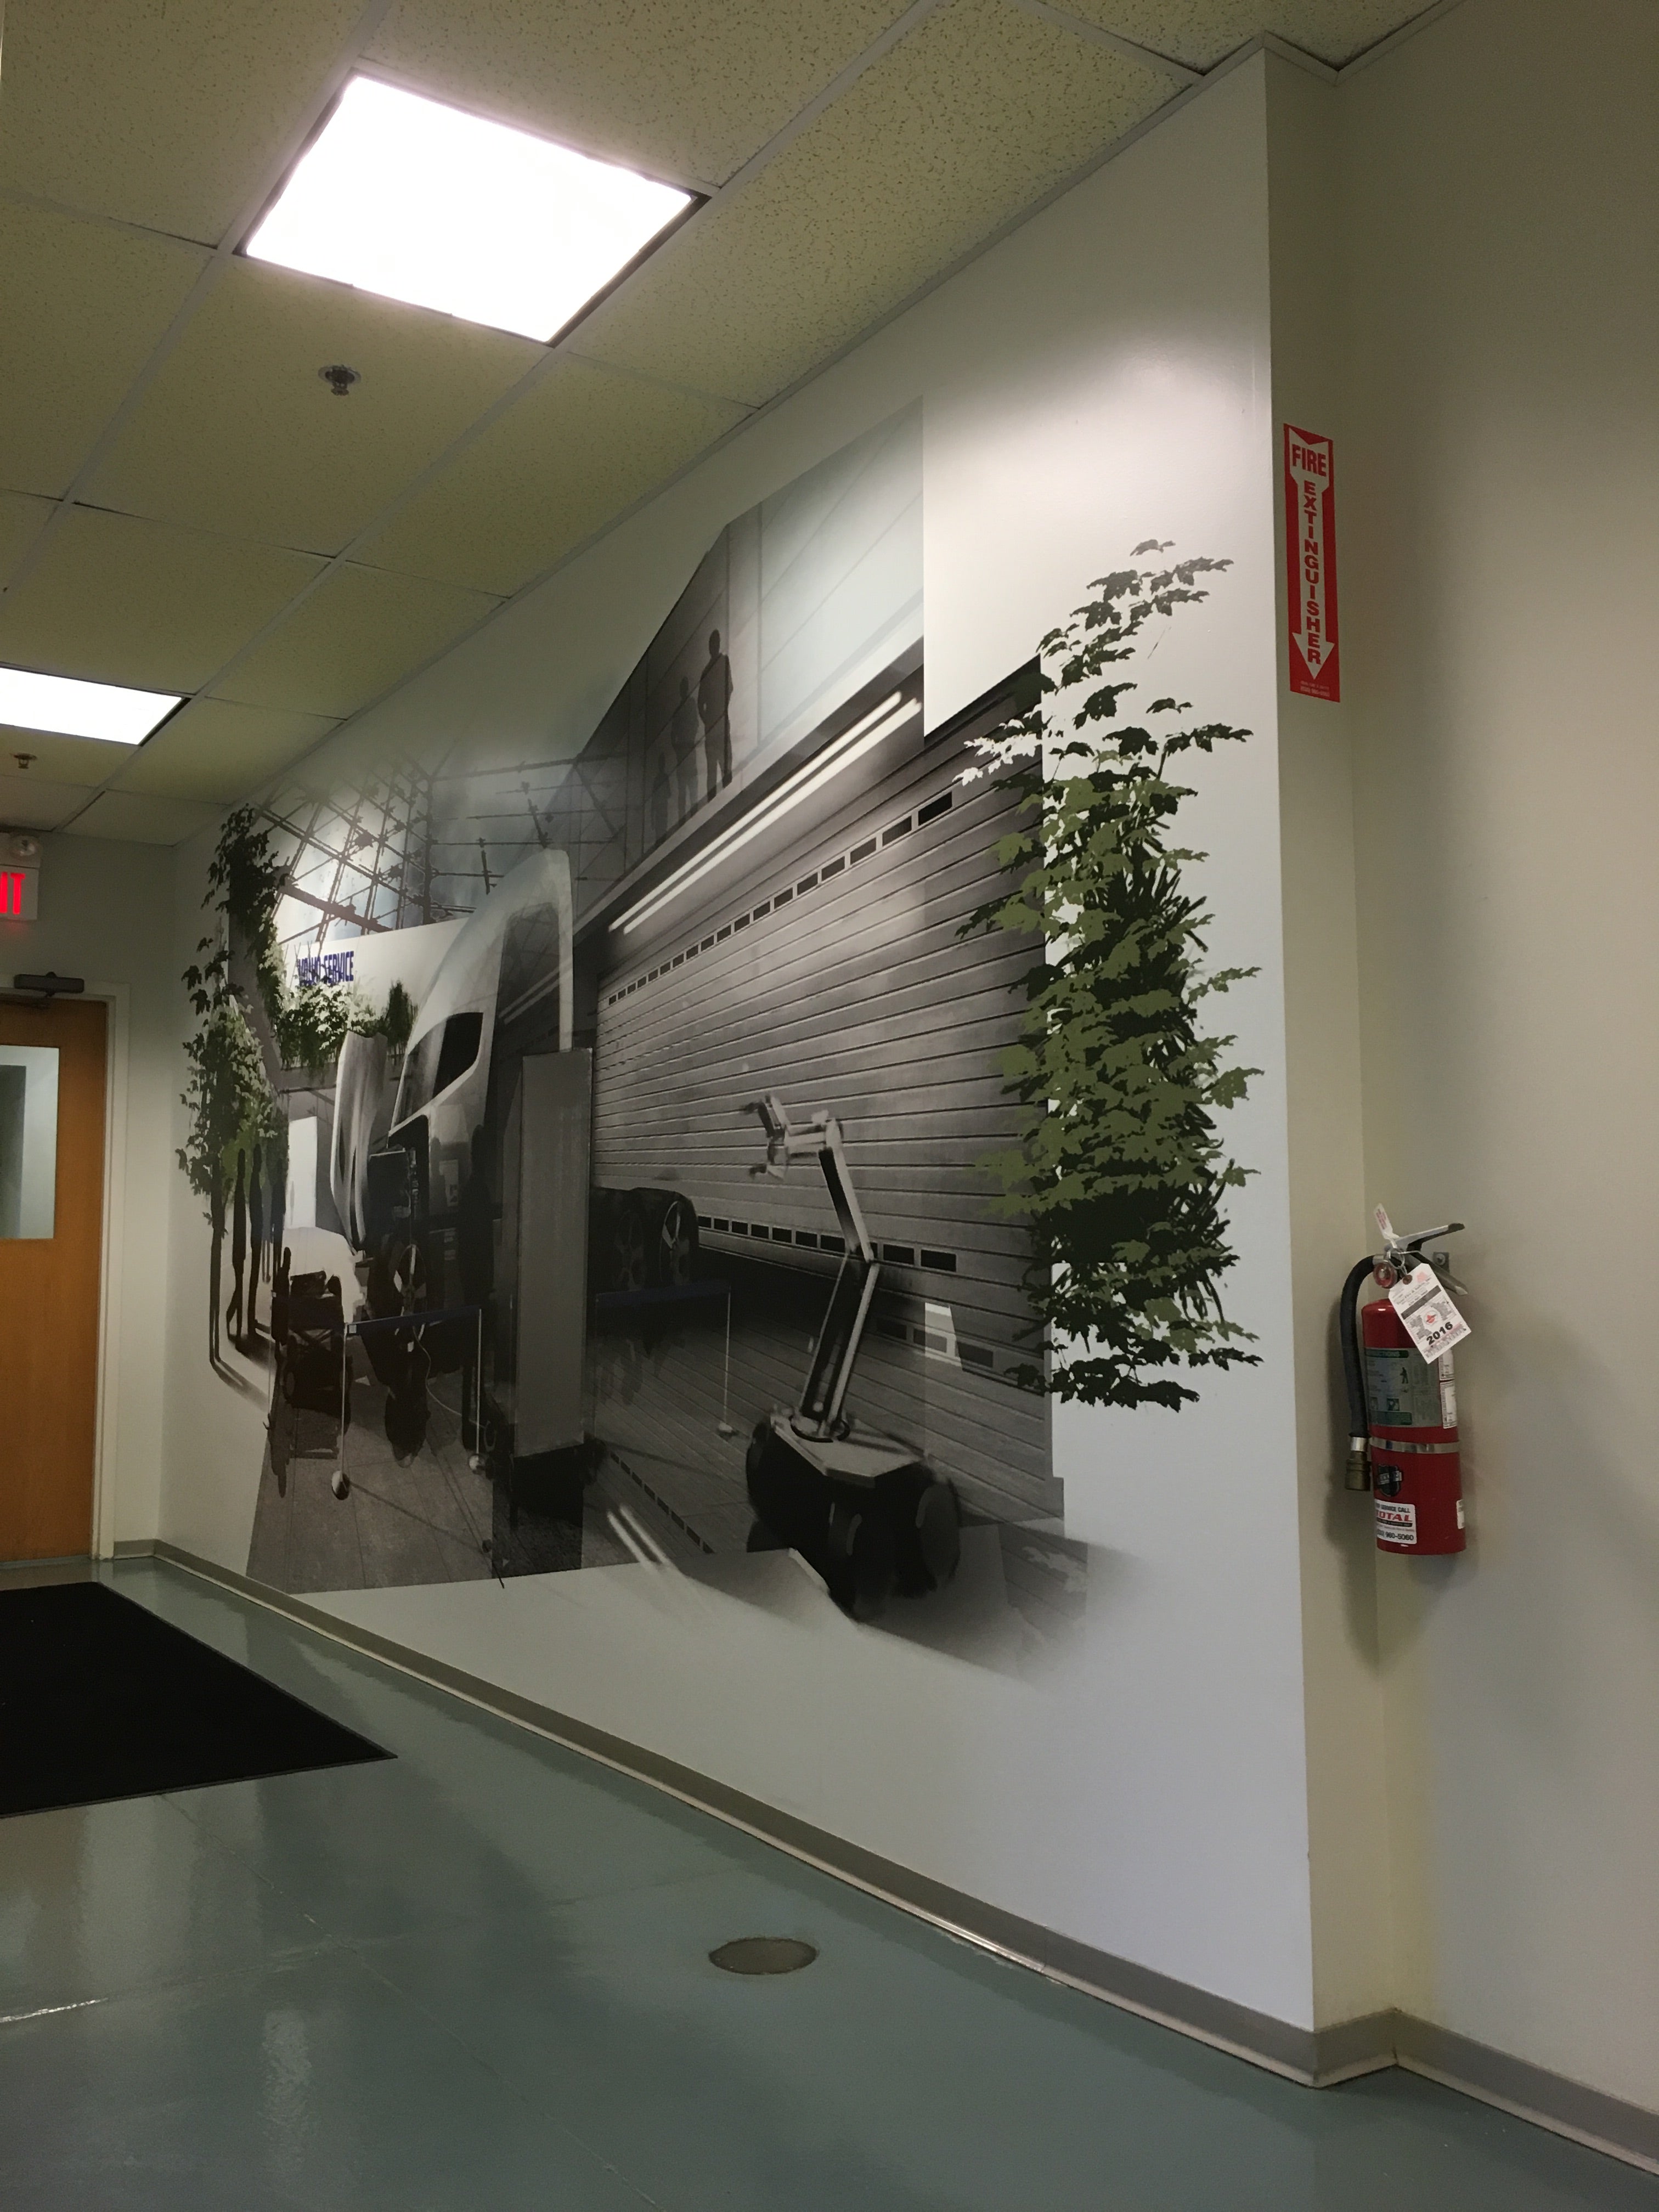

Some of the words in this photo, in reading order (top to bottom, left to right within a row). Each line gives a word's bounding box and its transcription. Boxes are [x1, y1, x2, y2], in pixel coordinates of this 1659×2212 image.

[1292, 443, 1327, 477] FIRE
[1304, 479, 1322, 665] EXTINGUISHER
[324, 951, 354, 983] SERVICE
[1426, 1321, 1453, 1345] 2016
